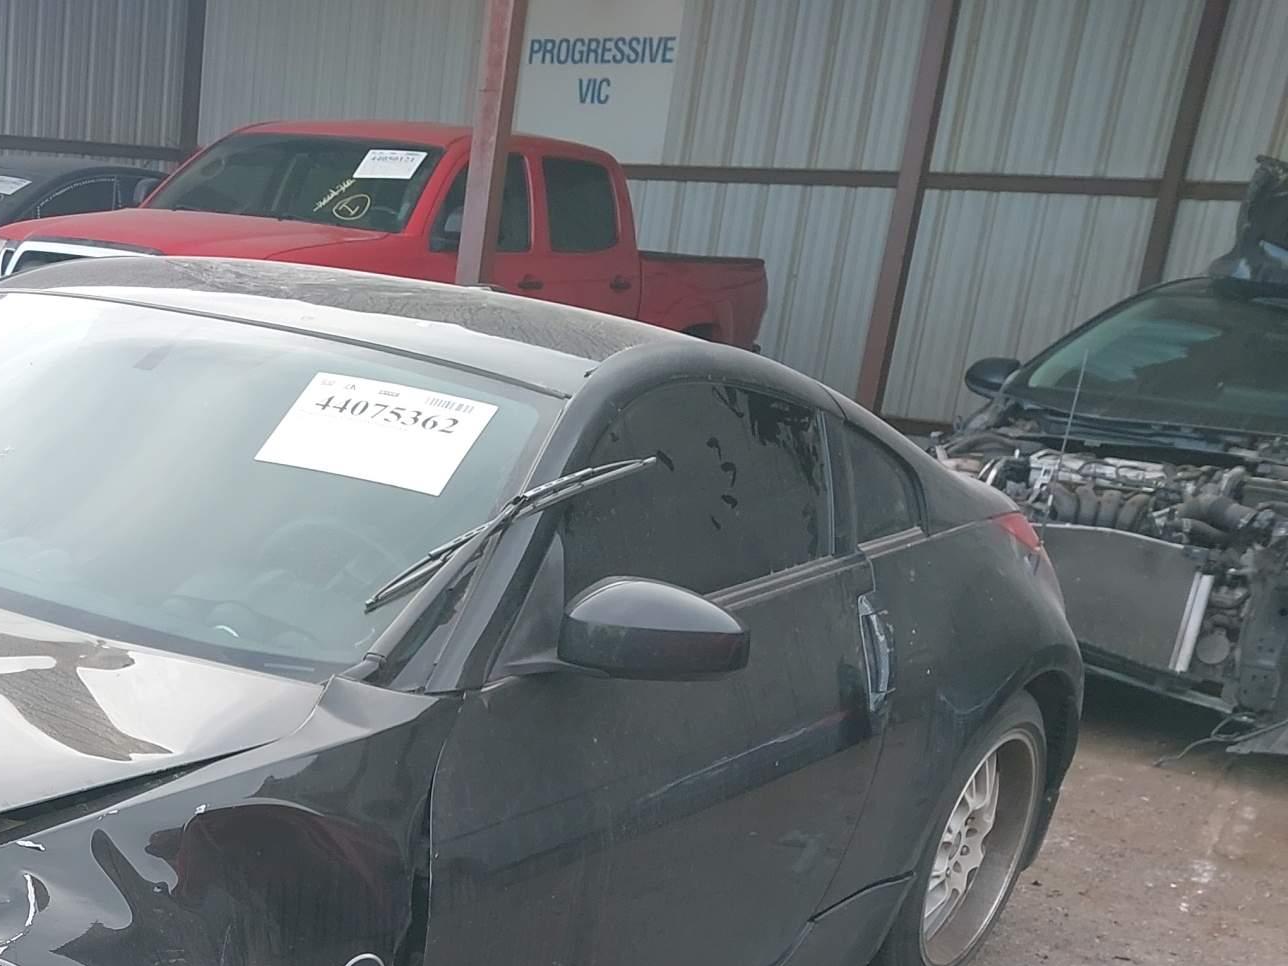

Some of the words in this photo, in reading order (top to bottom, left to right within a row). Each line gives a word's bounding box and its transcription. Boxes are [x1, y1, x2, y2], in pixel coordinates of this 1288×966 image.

[528, 36, 677, 65] PROGRESSIVE
[577, 77, 611, 105] VIC
[314, 394, 460, 434] 44075362
